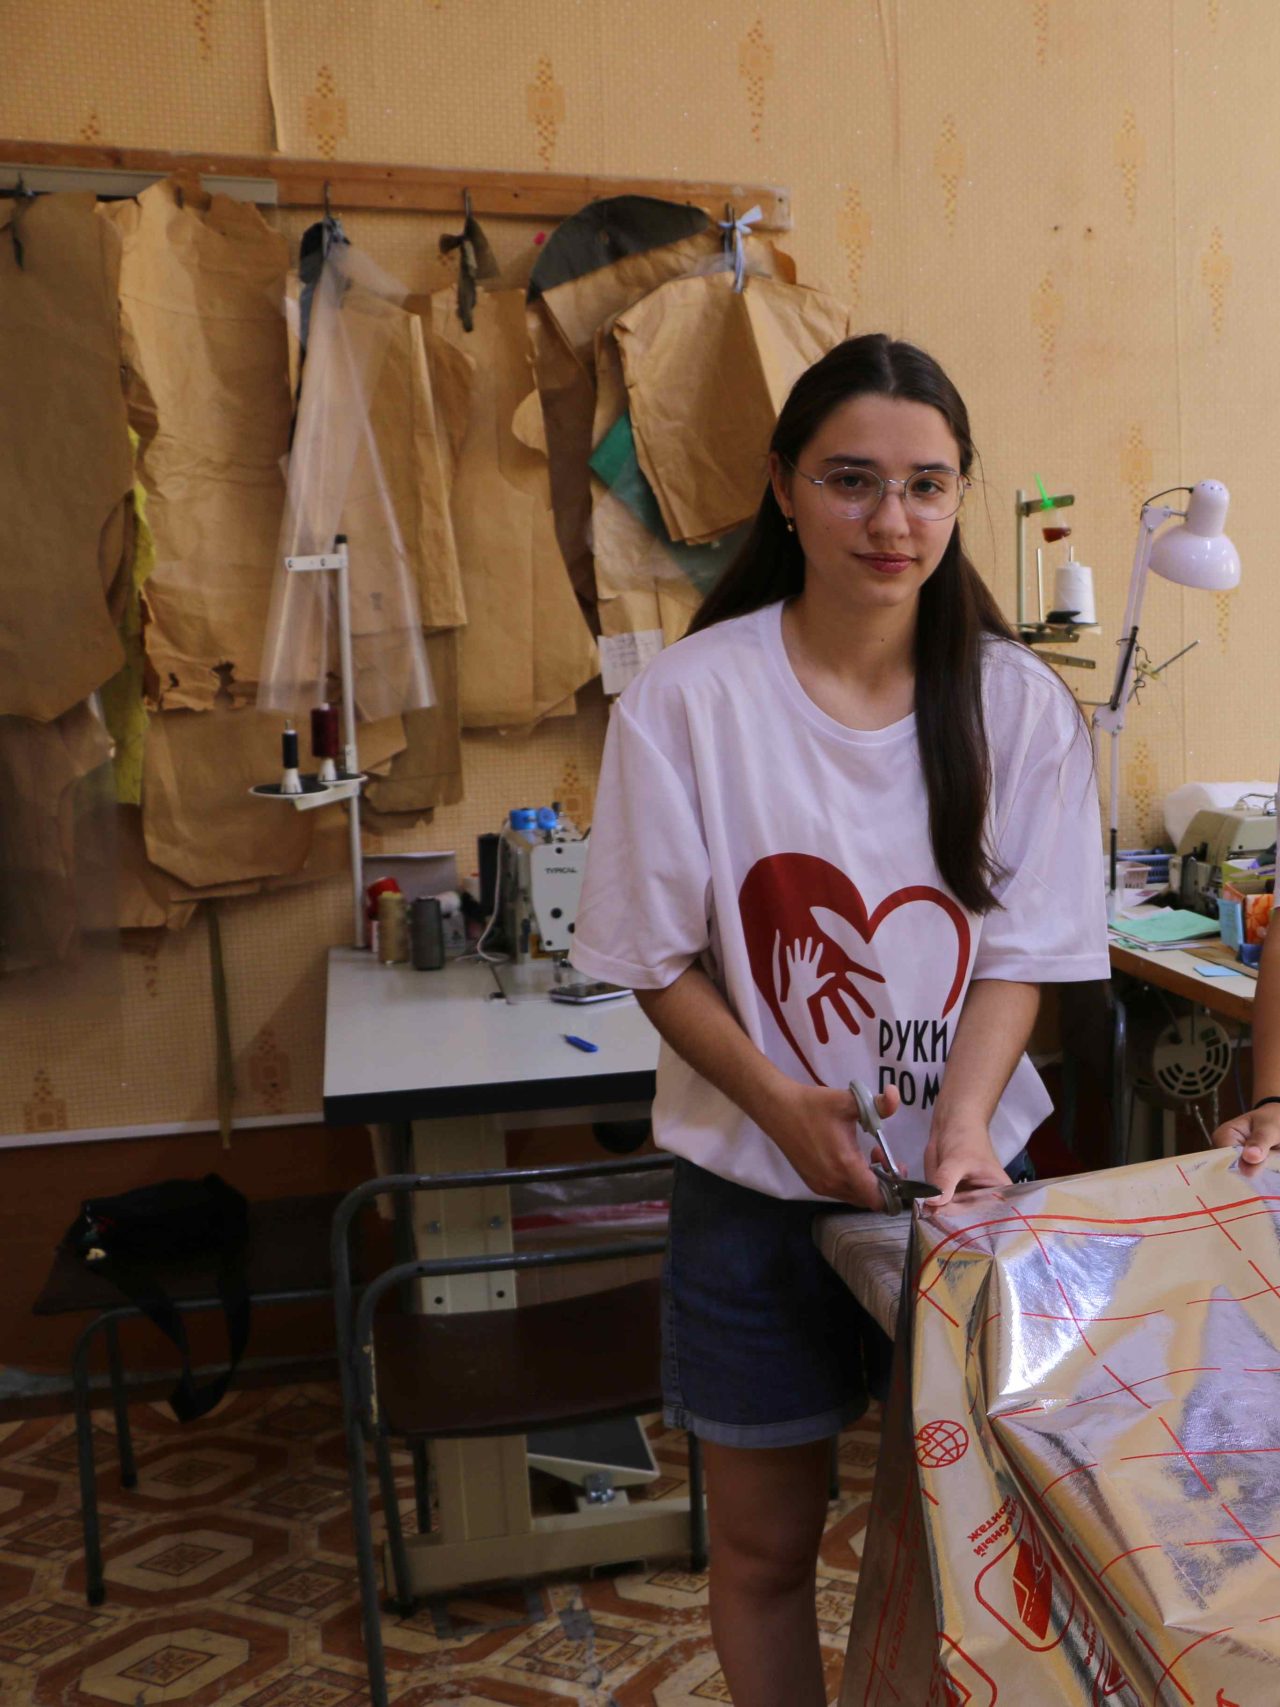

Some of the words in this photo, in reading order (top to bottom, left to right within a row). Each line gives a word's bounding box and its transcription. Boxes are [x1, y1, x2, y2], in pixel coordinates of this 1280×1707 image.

[545, 867, 577, 875] TYPICAL
[879, 1018, 948, 1063] РУКИ
[879, 1065, 941, 1110] ПОМ
